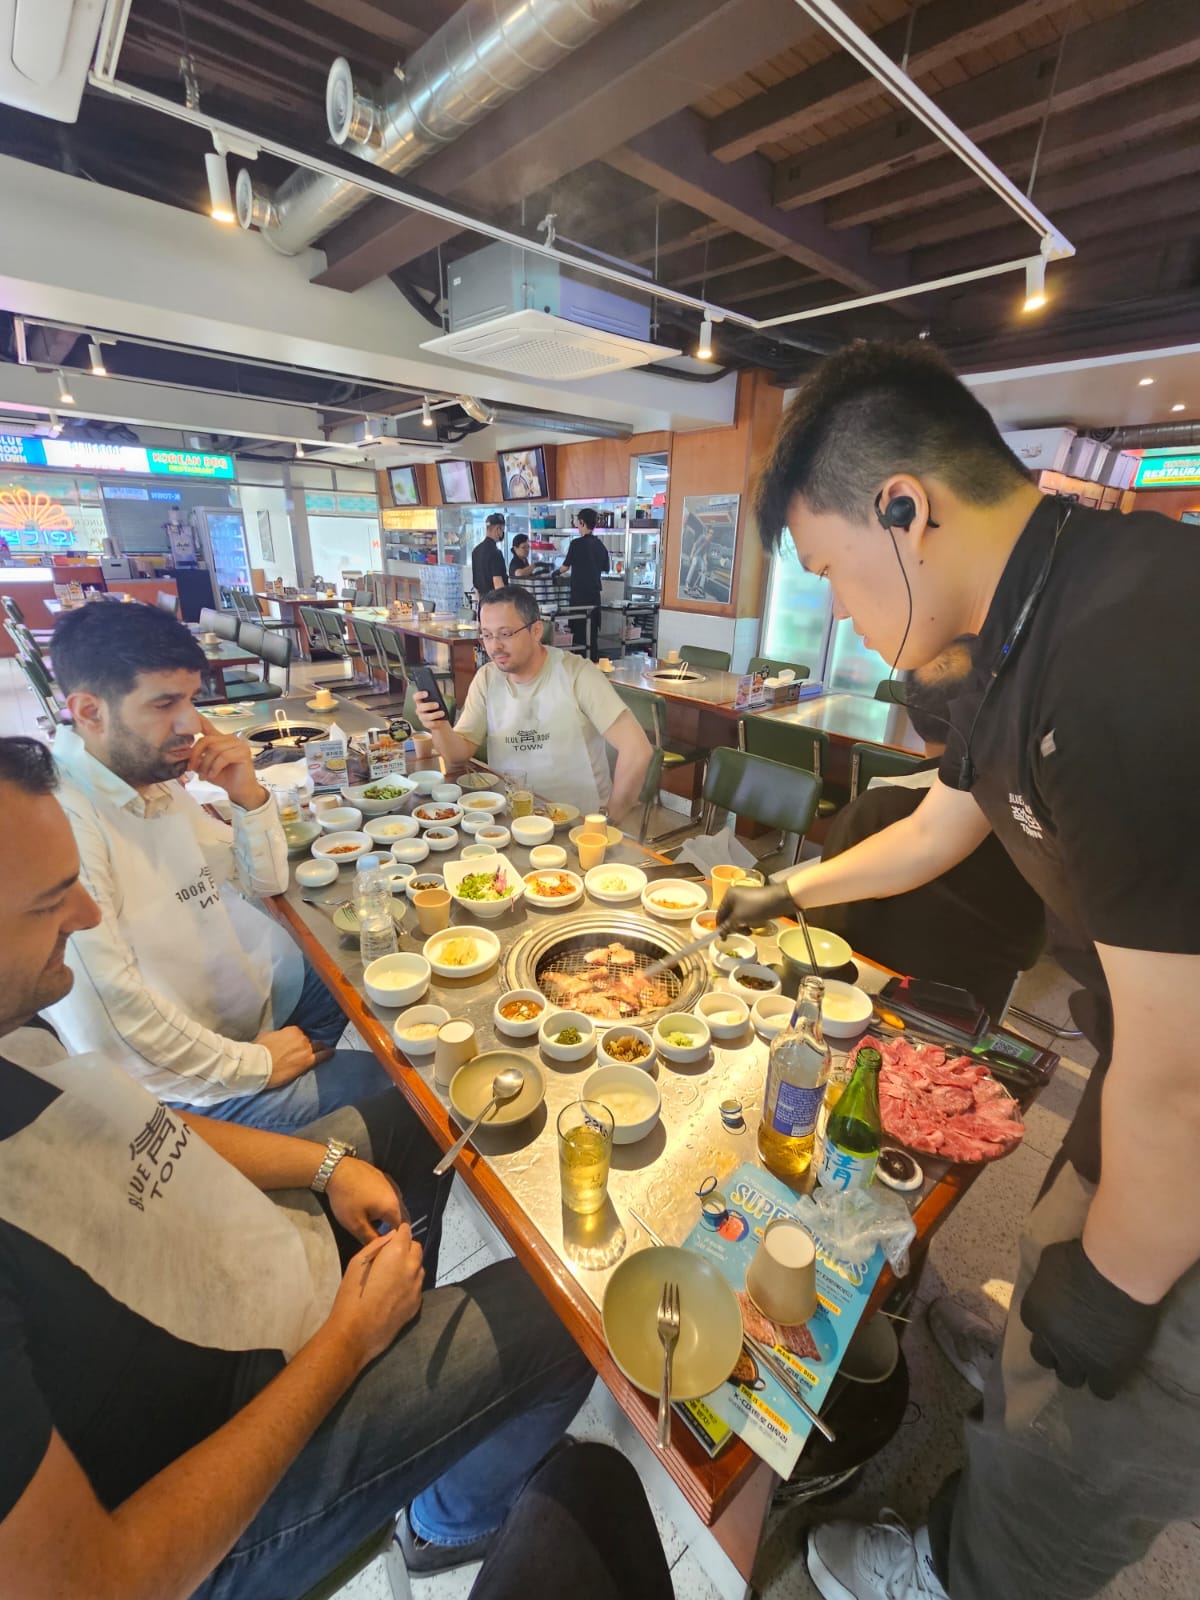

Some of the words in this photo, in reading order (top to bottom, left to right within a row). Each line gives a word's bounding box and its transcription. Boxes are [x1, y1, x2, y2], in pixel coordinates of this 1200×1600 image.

[0, 435, 23, 446] LUE
[152, 451, 201, 466] KOREAN
[204, 455, 228, 470] BBQ
[512, 743, 544, 752] TOWN
[127, 1163, 152, 1213] BLUE
